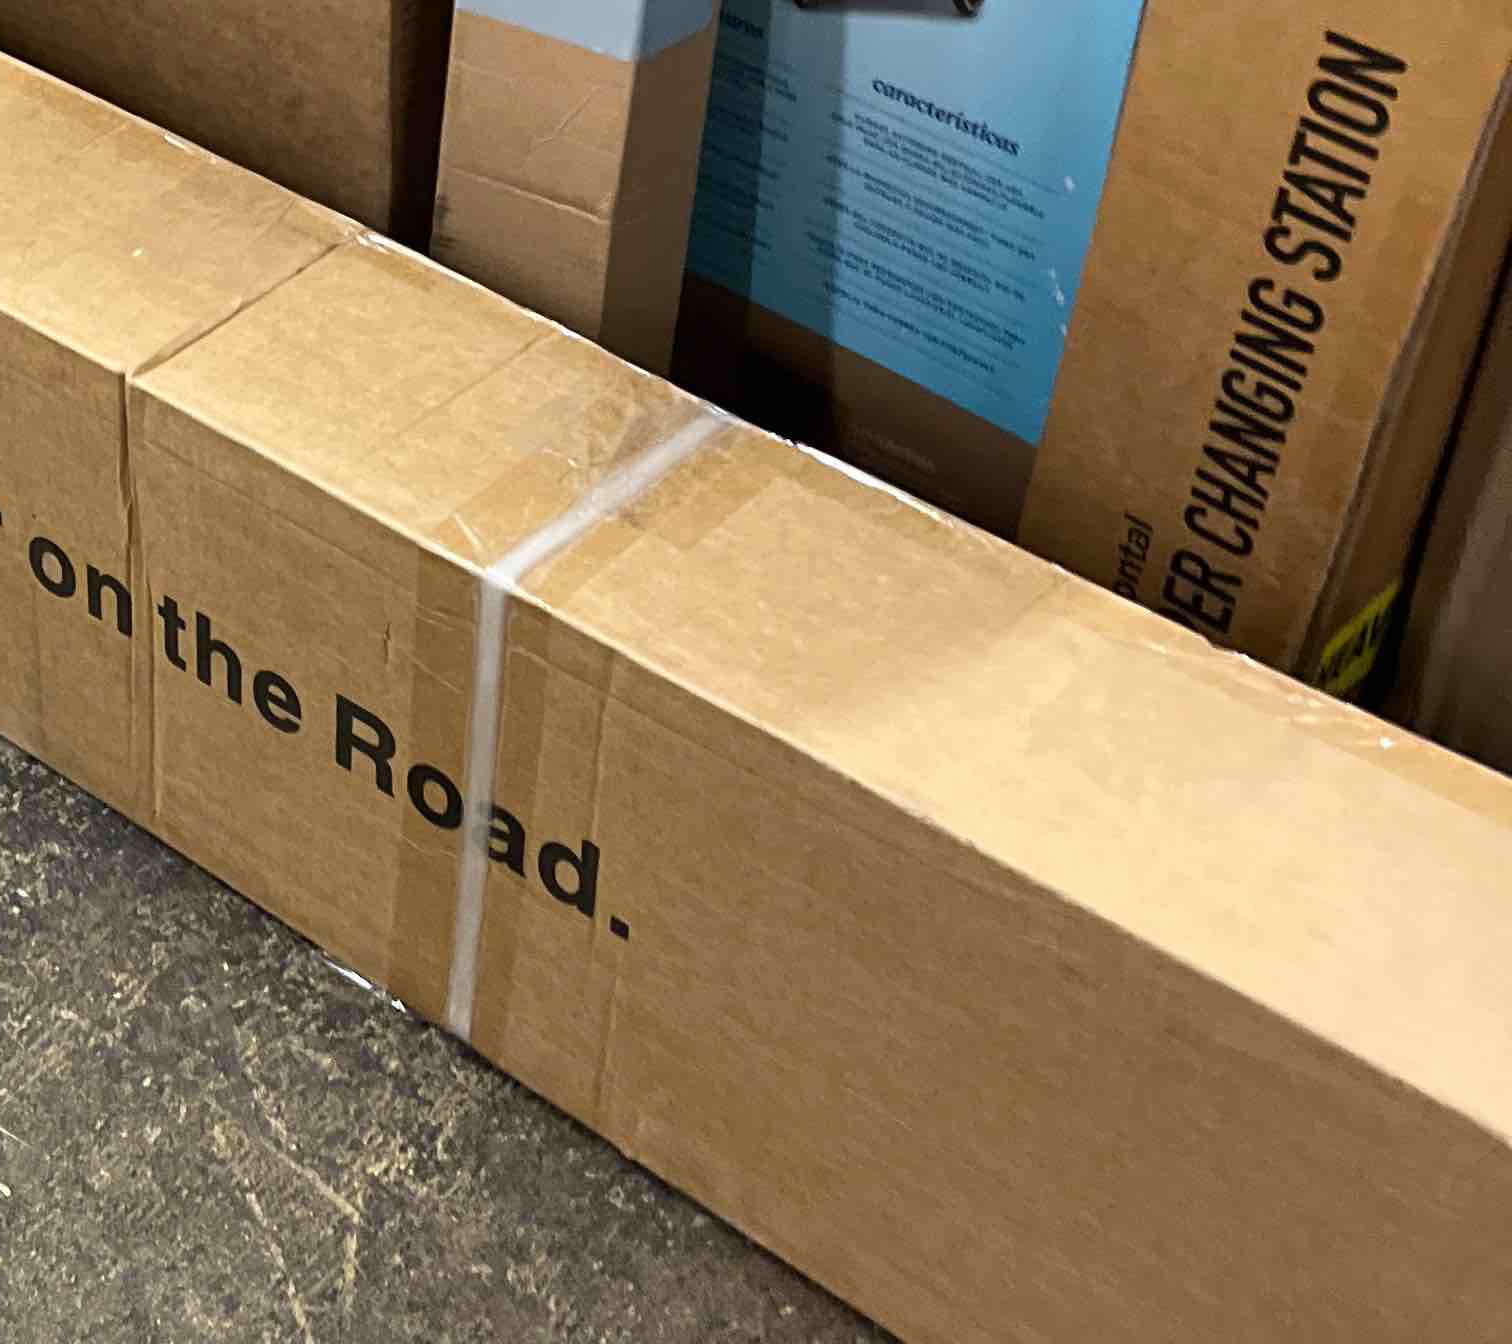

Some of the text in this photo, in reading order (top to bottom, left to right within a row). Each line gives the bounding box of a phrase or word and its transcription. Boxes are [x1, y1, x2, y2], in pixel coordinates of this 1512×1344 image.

[1183, 276, 1326, 556] CHANGING
[1263, 30, 1408, 283] STATION
[28, 535, 133, 638] on
[156, 594, 303, 734] the
[335, 692, 630, 941] Road.
